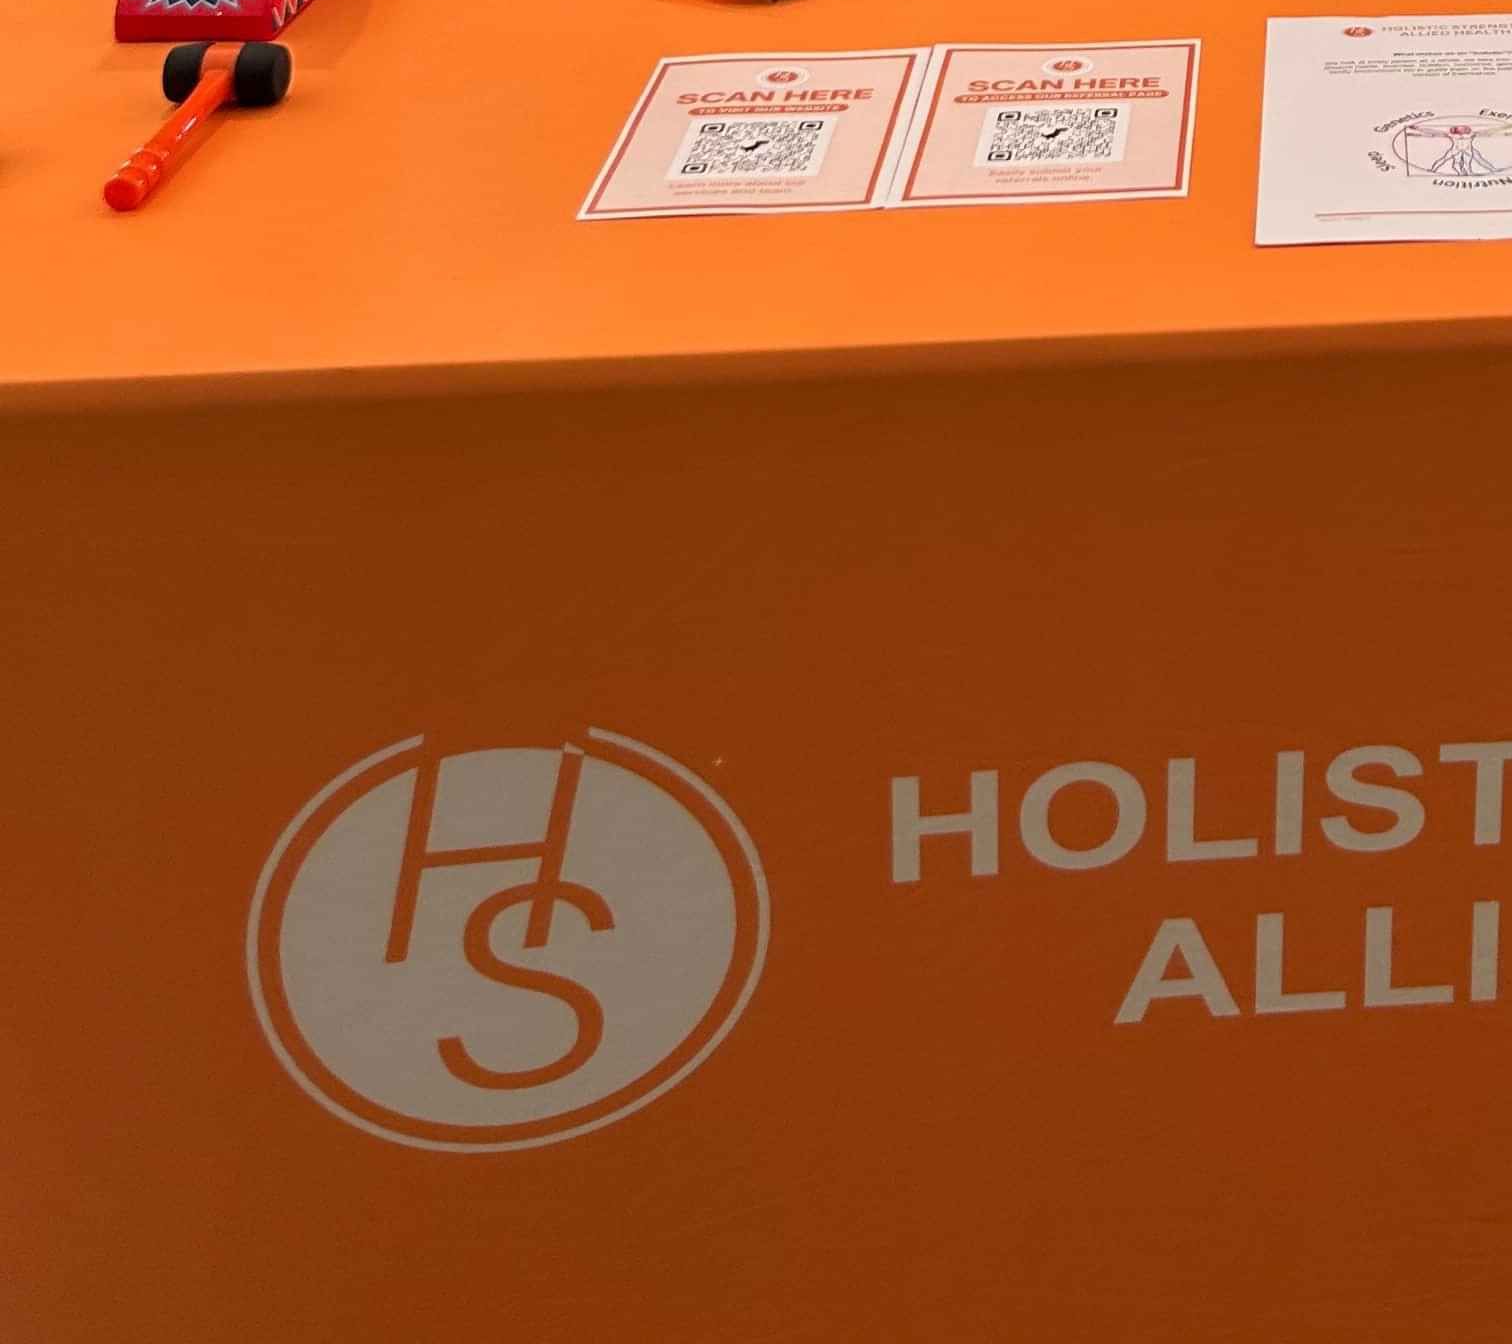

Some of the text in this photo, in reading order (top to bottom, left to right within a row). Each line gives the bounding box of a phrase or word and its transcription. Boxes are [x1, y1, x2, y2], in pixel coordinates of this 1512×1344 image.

[968, 77, 1162, 92] SCAN HERE
[676, 88, 875, 105] SCAN HERE
[1373, 110, 1435, 134] Genetics
